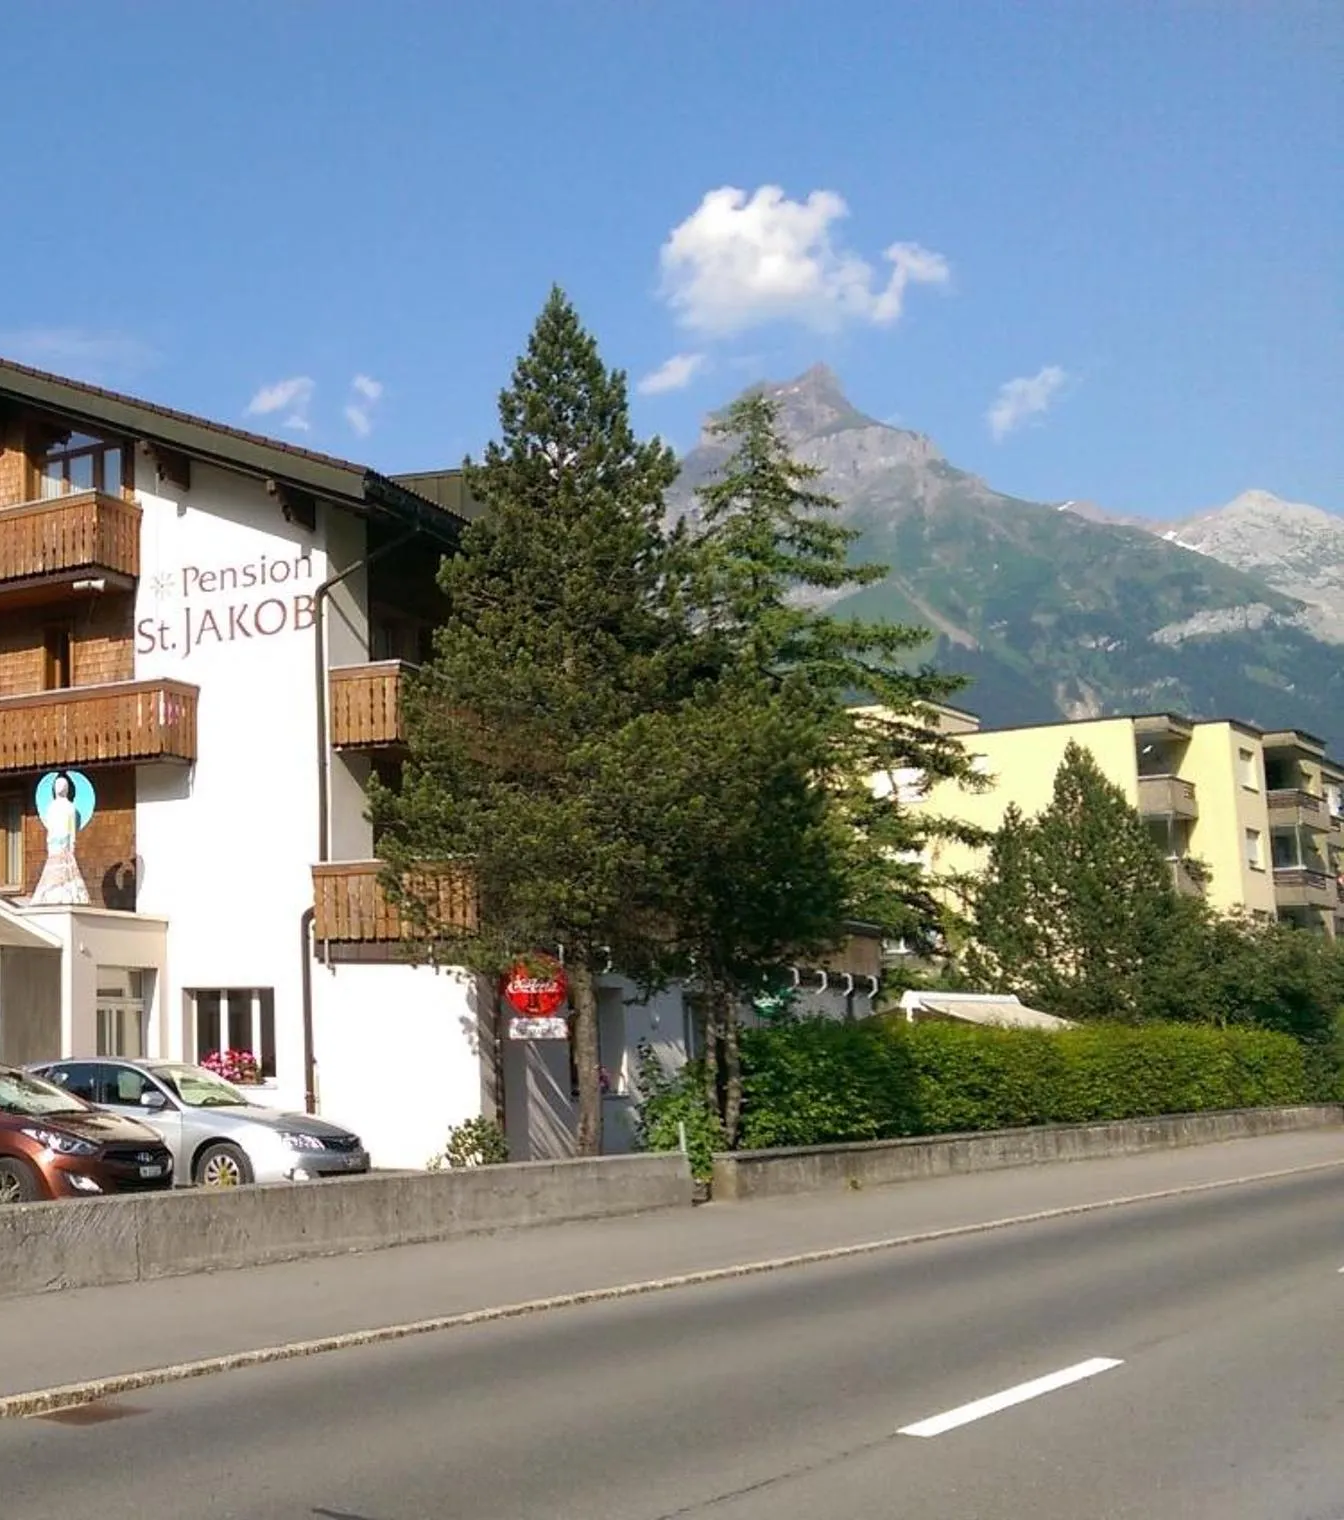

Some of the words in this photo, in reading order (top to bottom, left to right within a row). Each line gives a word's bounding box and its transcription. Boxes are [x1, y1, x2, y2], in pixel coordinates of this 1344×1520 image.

[182, 555, 312, 597] Pension
[137, 617, 176, 655] St.
[182, 594, 316, 660] JAKOB
